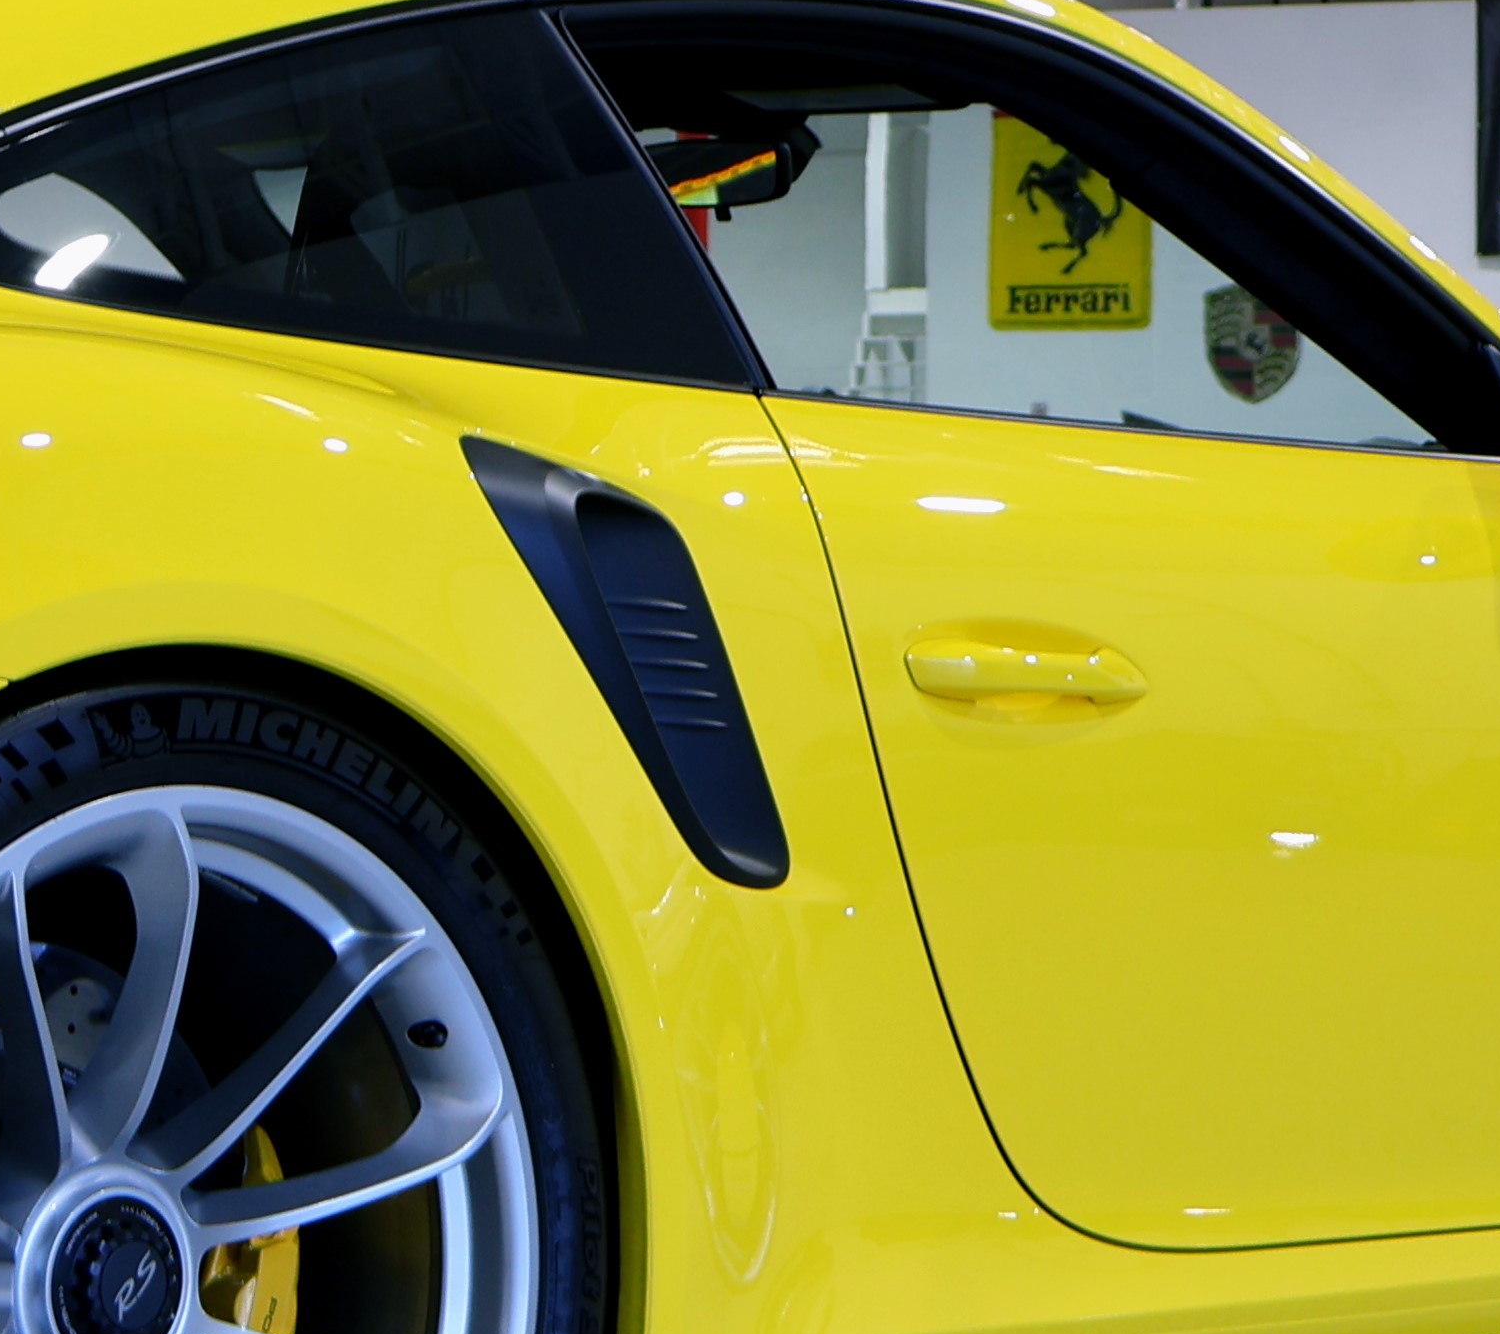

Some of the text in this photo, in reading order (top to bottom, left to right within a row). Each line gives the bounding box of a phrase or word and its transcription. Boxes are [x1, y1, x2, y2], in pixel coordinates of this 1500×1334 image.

[1005, 284, 1131, 314] Ferrari
[173, 696, 462, 852] MICHELIN
[114, 1249, 157, 1323] RS
